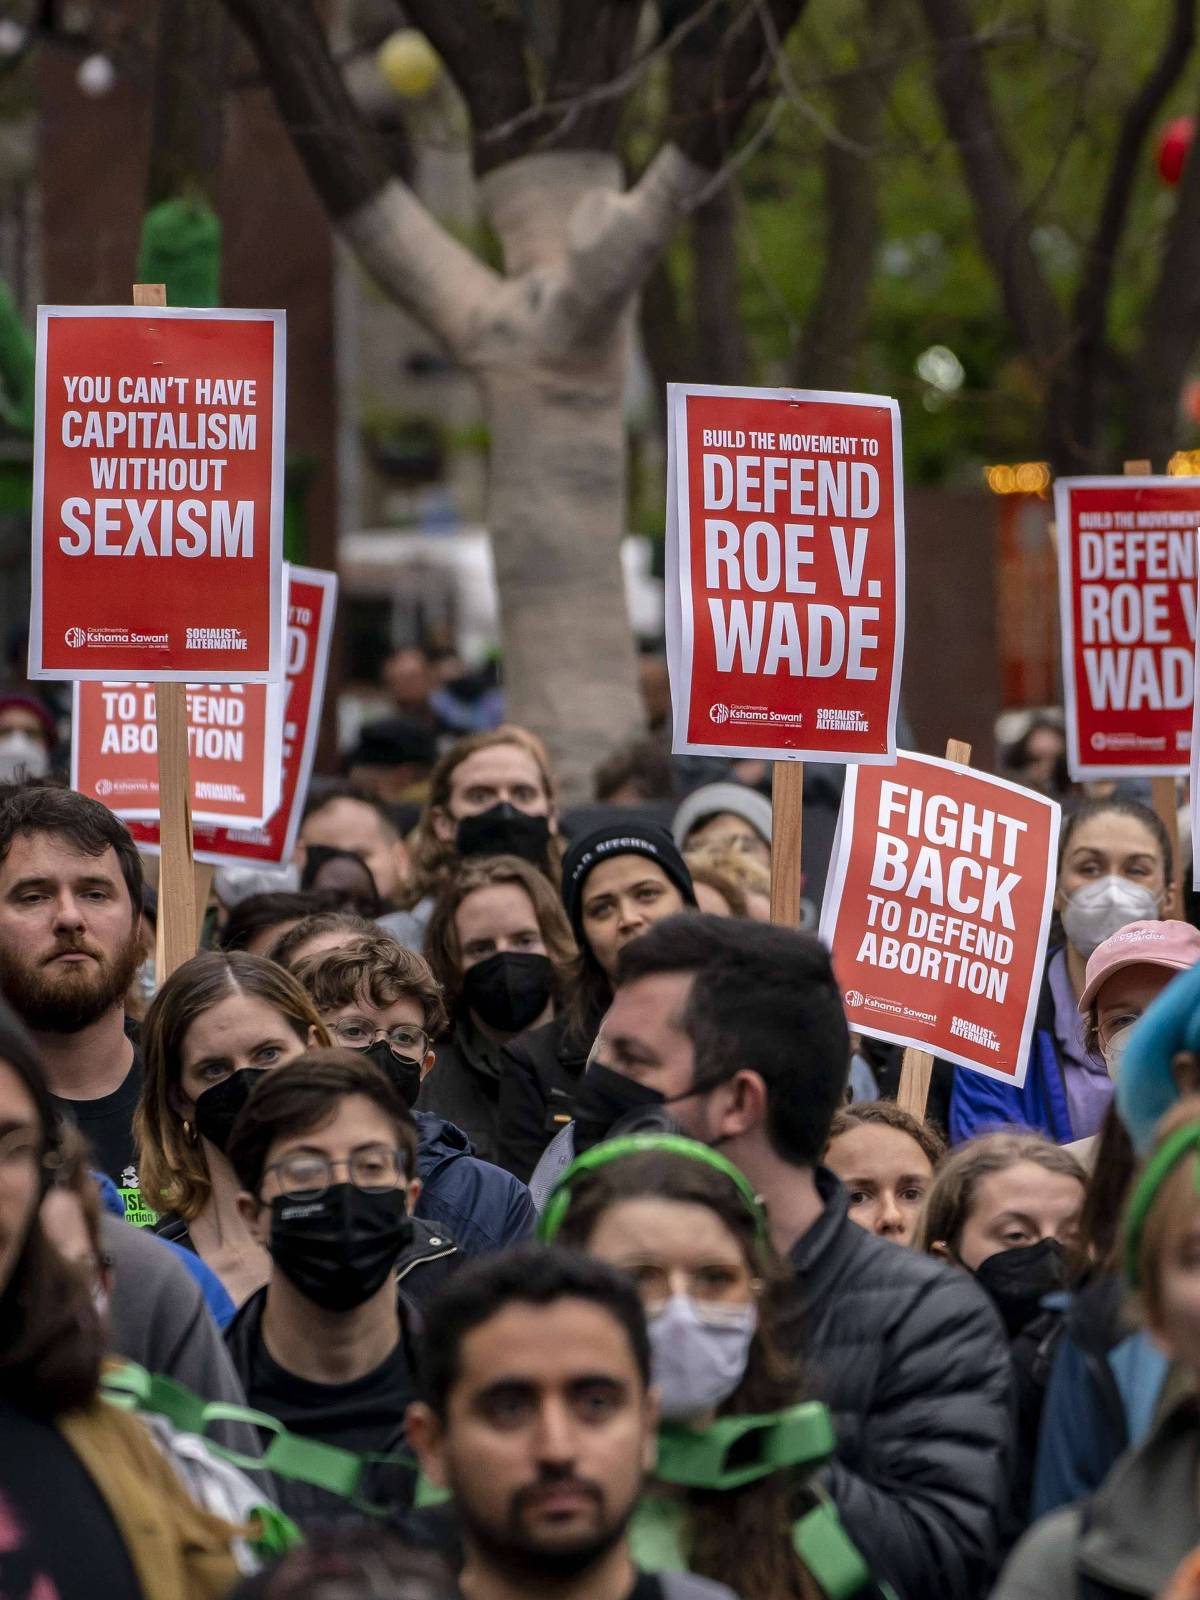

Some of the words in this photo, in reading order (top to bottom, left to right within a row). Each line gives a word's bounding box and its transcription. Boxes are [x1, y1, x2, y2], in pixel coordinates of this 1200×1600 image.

[63, 376, 110, 403] YOU
[117, 377, 189, 405] CAN'T
[195, 378, 257, 406] HAVE
[61, 411, 257, 451] CAPITALISM
[703, 430, 746, 449] BUILD
[749, 431, 775, 451] THE
[779, 433, 857, 456] MOVEMENT
[861, 438, 879, 456] TO
[90, 457, 227, 492] WITHOUT
[703, 454, 880, 518] DEFEND
[59, 498, 255, 558] SEXISM
[704, 519, 816, 595] ROE
[829, 526, 882, 598] V.
[1080, 531, 1197, 580] DEFEN
[1082, 583, 1170, 644] ROE
[87, 633, 128, 643] Kshama
[131, 633, 169, 643] Sawant
[186, 628, 236, 639] SOCIALIST
[186, 639, 247, 650] ALTERNATIVE
[707, 597, 881, 681] WADE
[1083, 647, 1194, 712] WAD
[101, 692, 137, 721] TO
[730, 710, 767, 720] Kshama
[770, 711, 801, 722] Sawant
[817, 709, 860, 721] SOCIALIST
[816, 720, 868, 731] ALTERNATIVE
[877, 780, 1028, 866] FIGHT
[870, 831, 1023, 931] BACK
[867, 894, 902, 932] TO
[908, 909, 1014, 966] DEFEND
[856, 933, 1009, 1004] ABORTION
[864, 998, 901, 1014] Kshama
[903, 1007, 937, 1022] Sawant
[951, 1016, 993, 1039] SOCIALIST
[950, 1025, 1001, 1052] ALTERNATIVE
